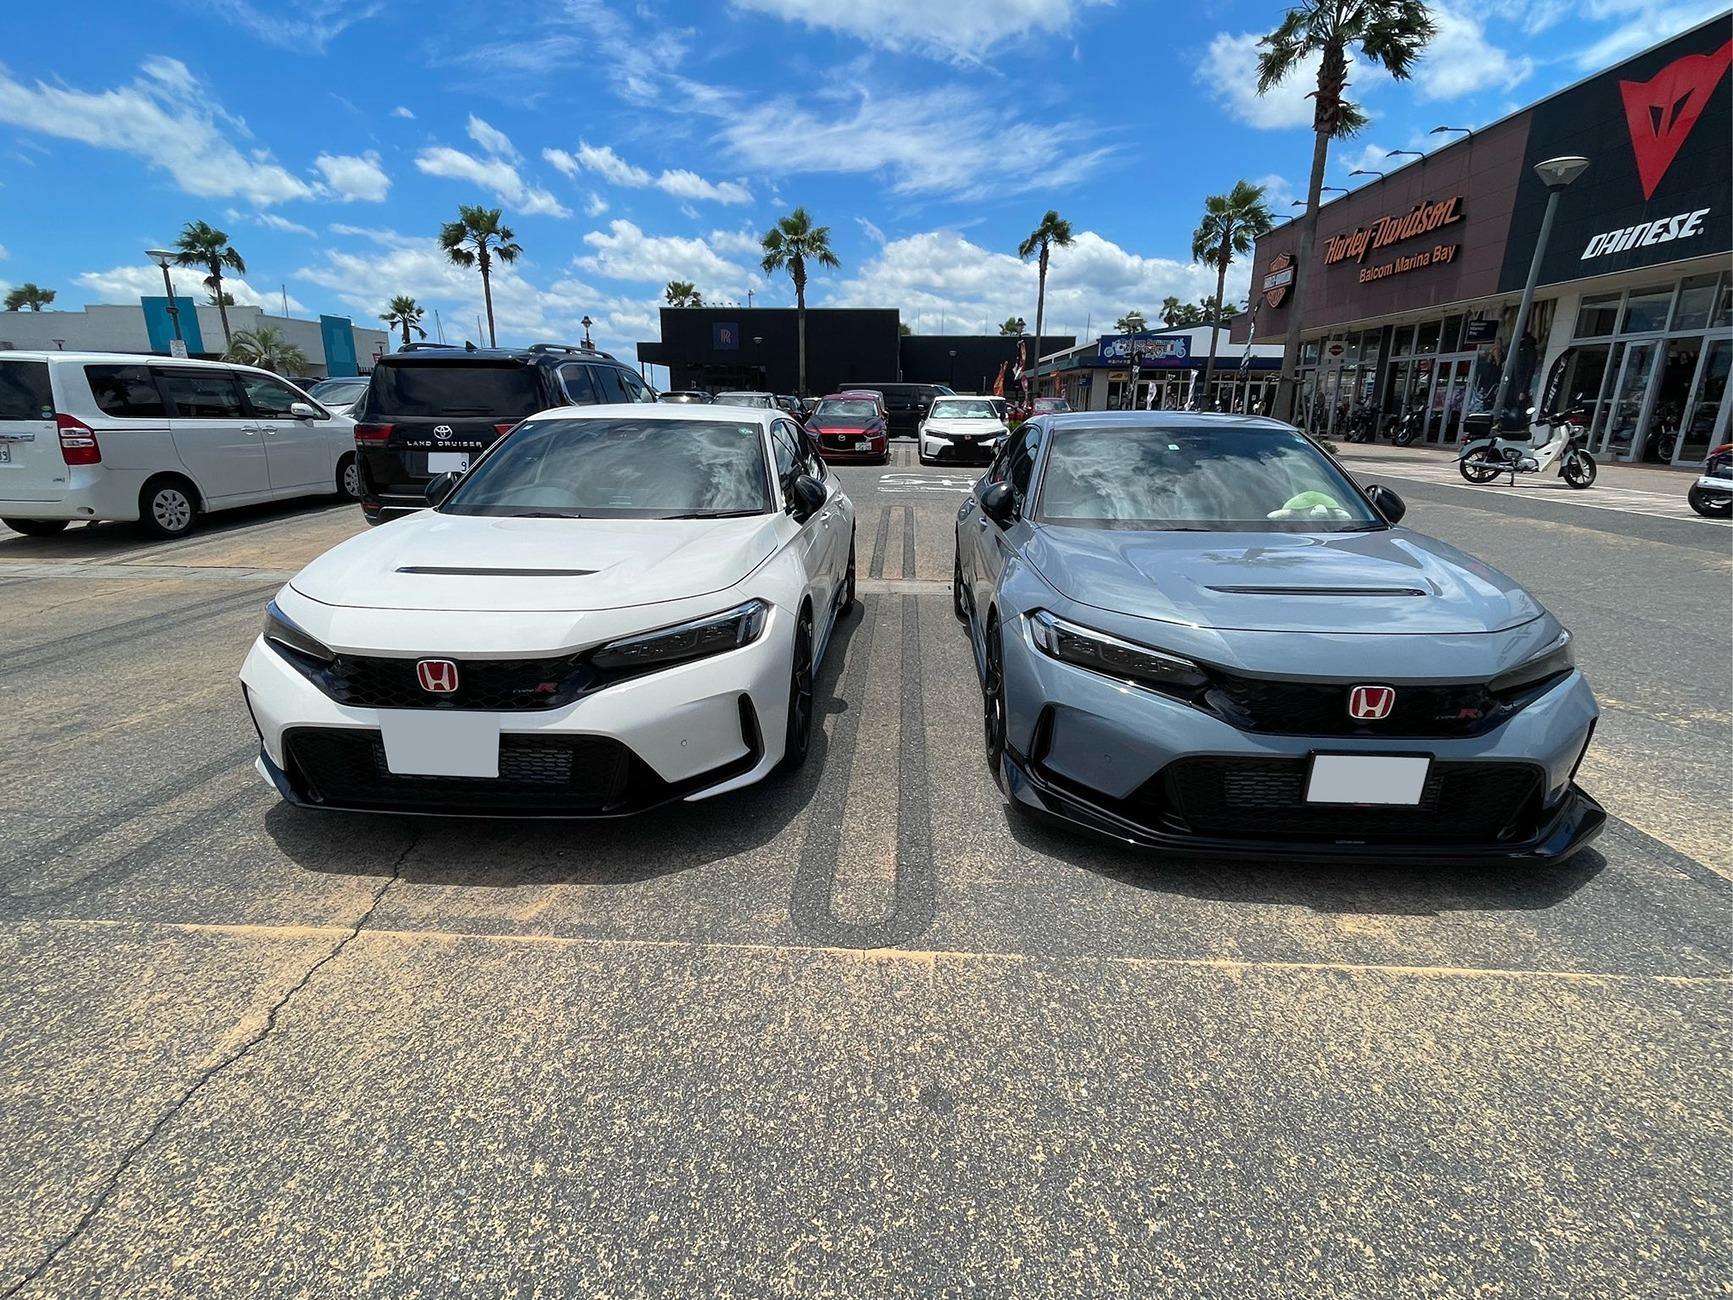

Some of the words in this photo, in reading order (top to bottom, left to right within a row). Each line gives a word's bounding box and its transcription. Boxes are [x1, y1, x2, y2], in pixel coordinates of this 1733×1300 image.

[1324, 196, 1461, 265] Harley-Davidson
[1359, 262, 1393, 283] Balcom
[1394, 252, 1430, 274] Marina
[1432, 244, 1456, 264] Bay
[437, 440, 483, 448] CRUISER
